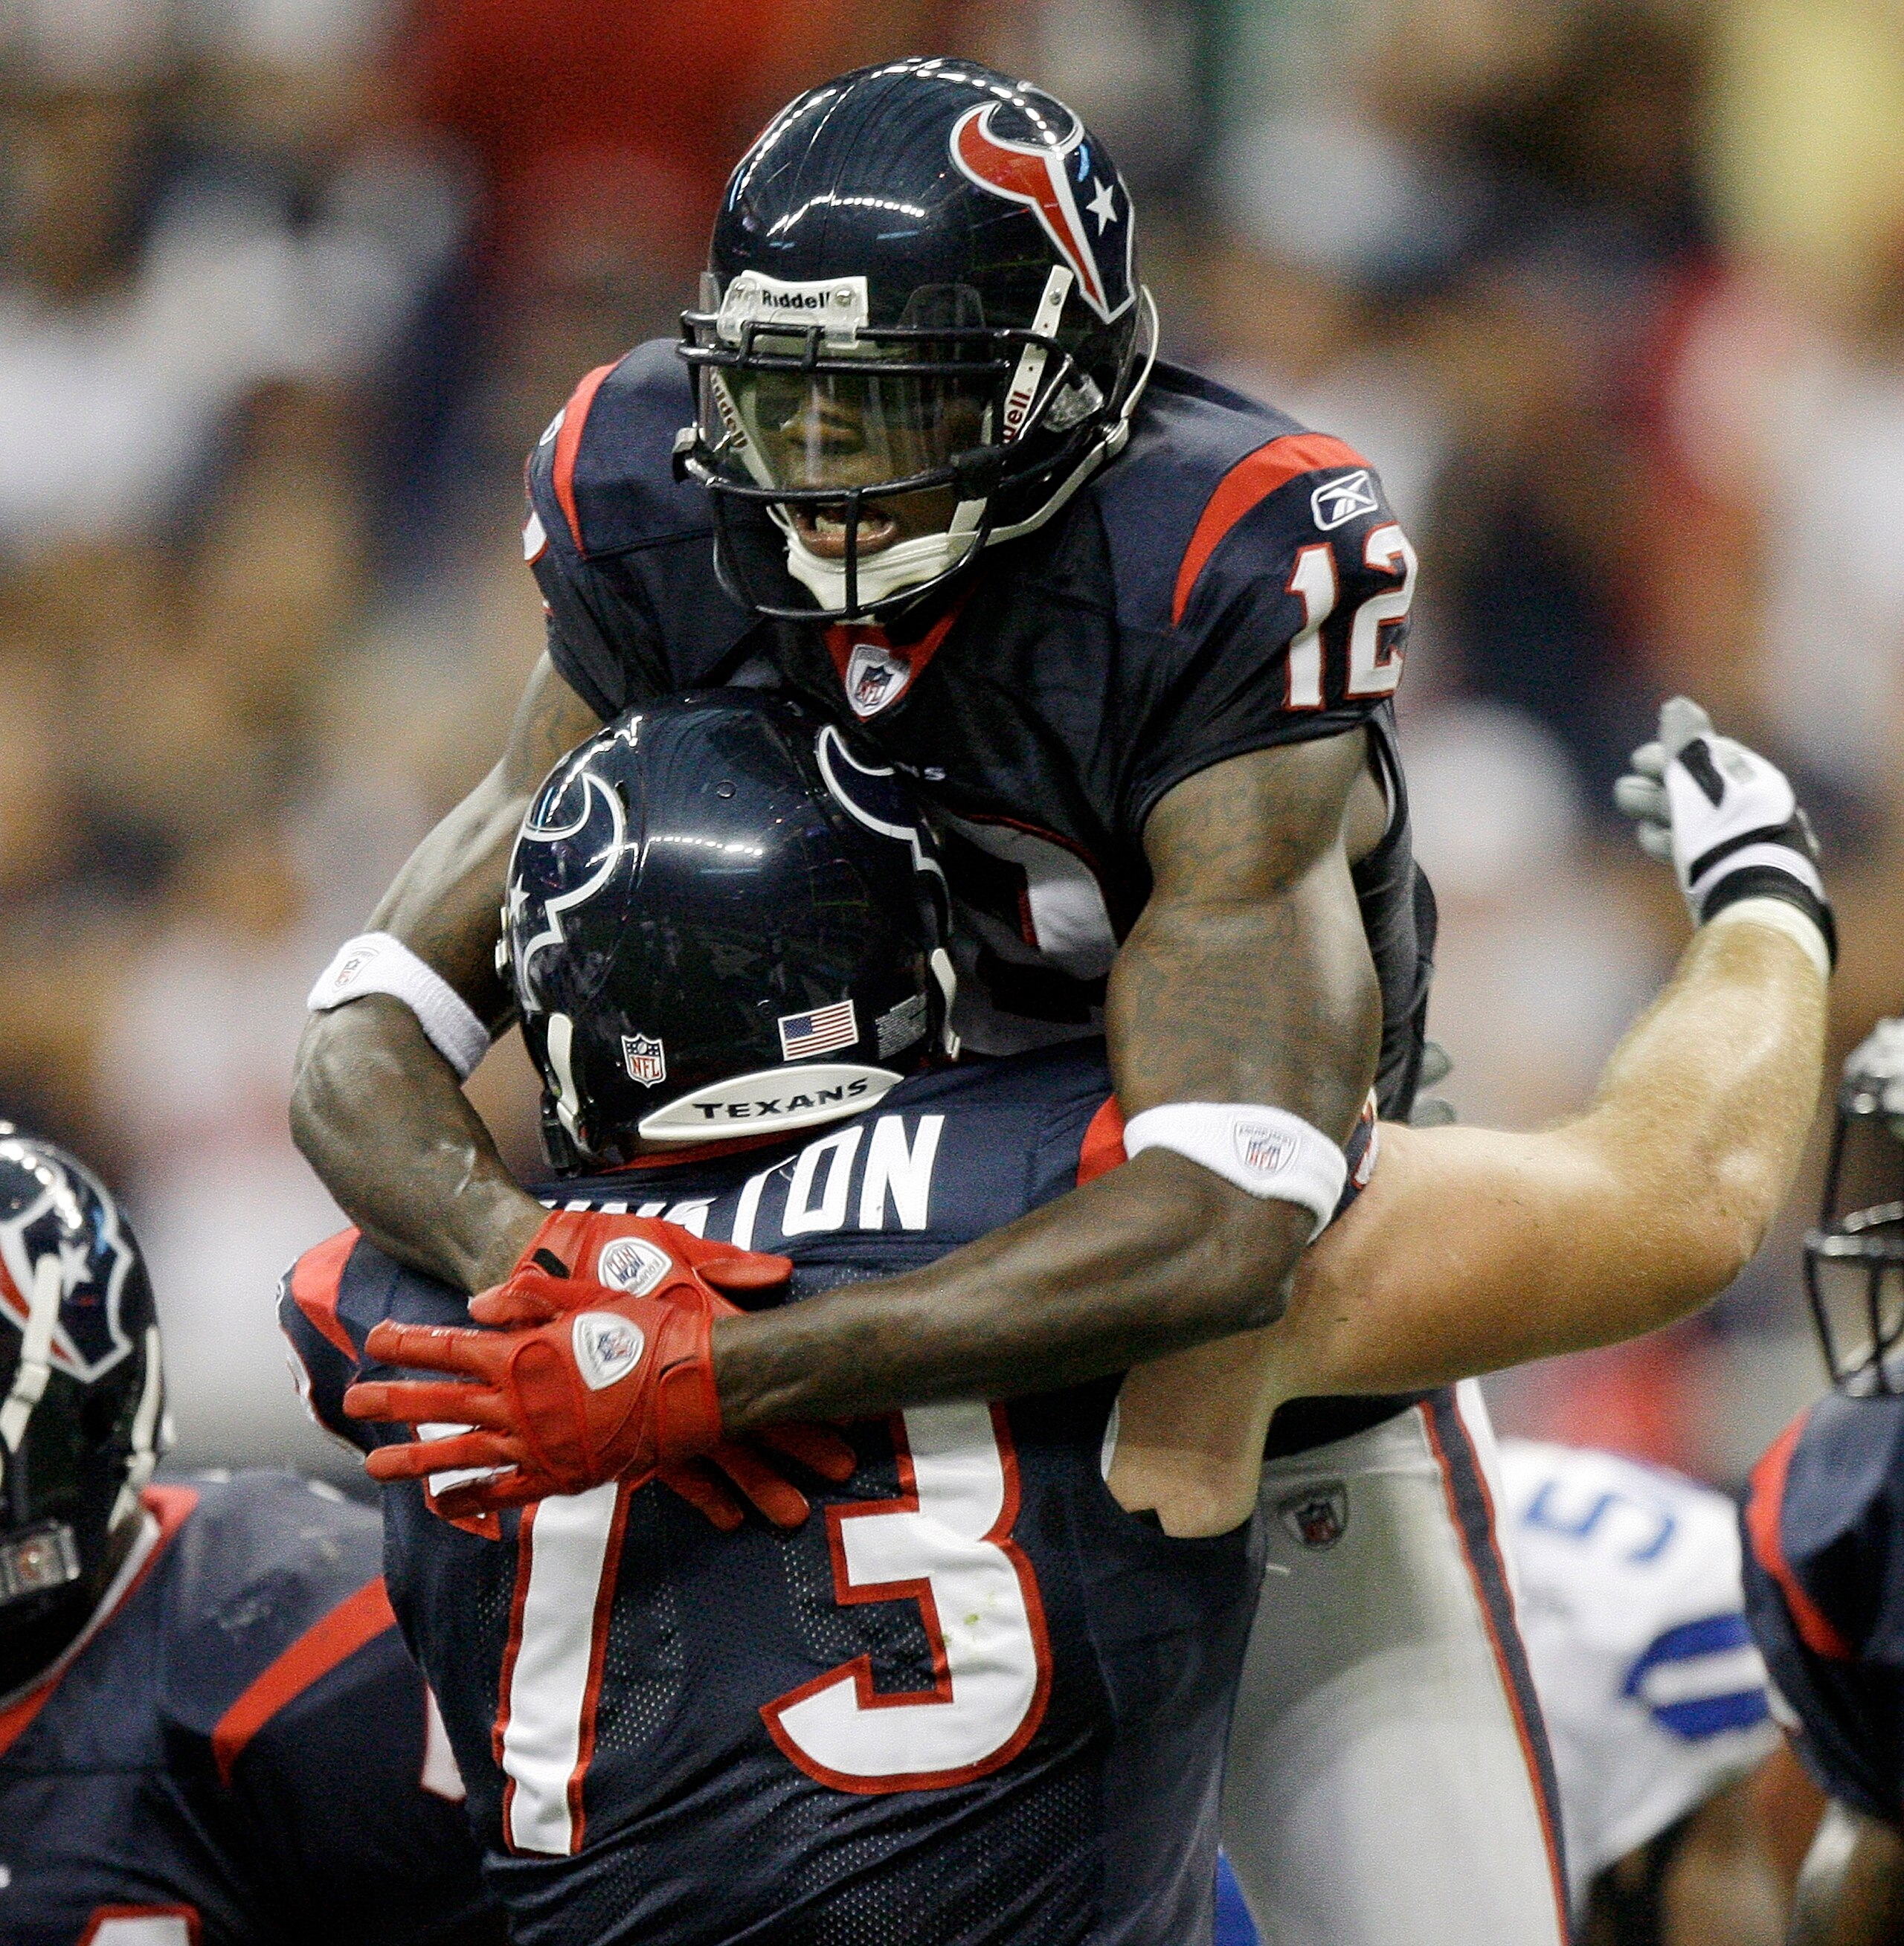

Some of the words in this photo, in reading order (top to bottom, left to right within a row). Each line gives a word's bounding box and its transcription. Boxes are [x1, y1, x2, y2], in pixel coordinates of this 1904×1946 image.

[1284, 521, 1419, 711] 12
[631, 1056, 660, 1080] NFL
[692, 1077, 869, 1119] TEXANS
